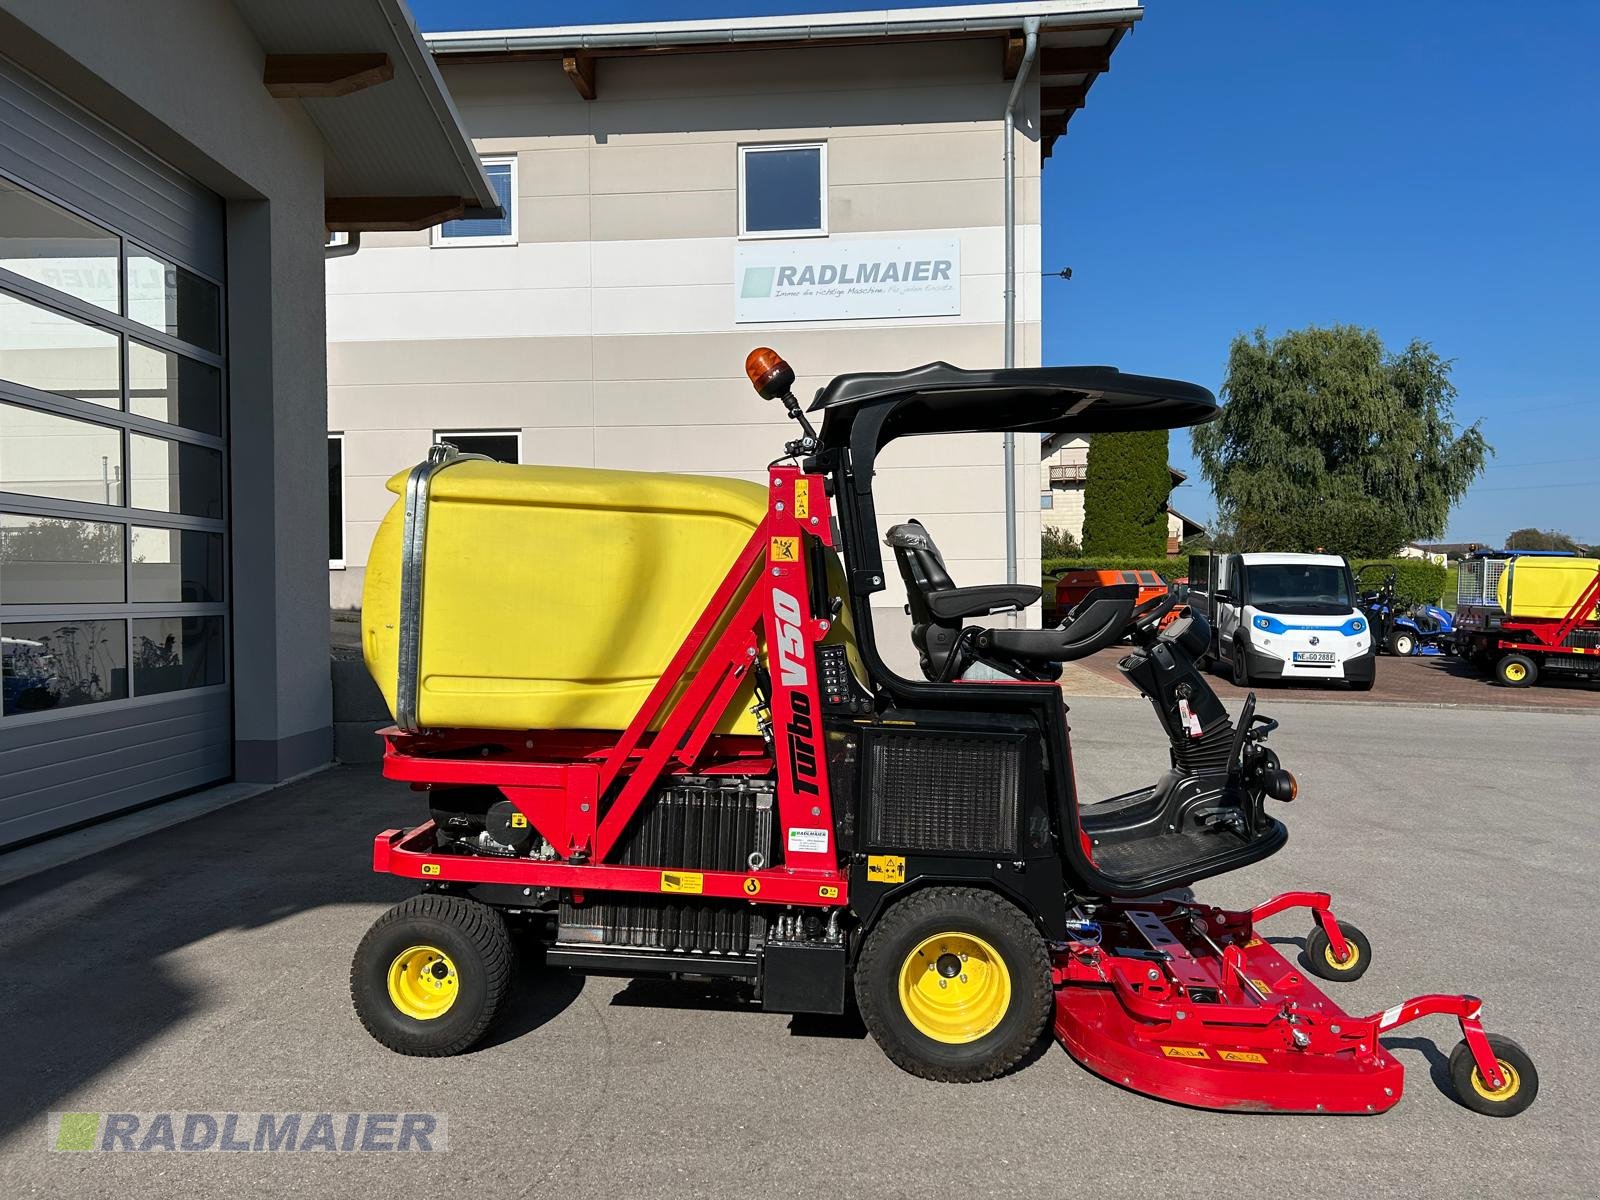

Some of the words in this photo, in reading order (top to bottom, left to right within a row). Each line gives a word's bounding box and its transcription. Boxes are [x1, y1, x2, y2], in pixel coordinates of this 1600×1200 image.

[776, 259, 952, 287] RADLMAIER
[775, 289, 800, 297] Immer
[816, 288, 845, 298] richtige
[772, 587, 808, 686] V50
